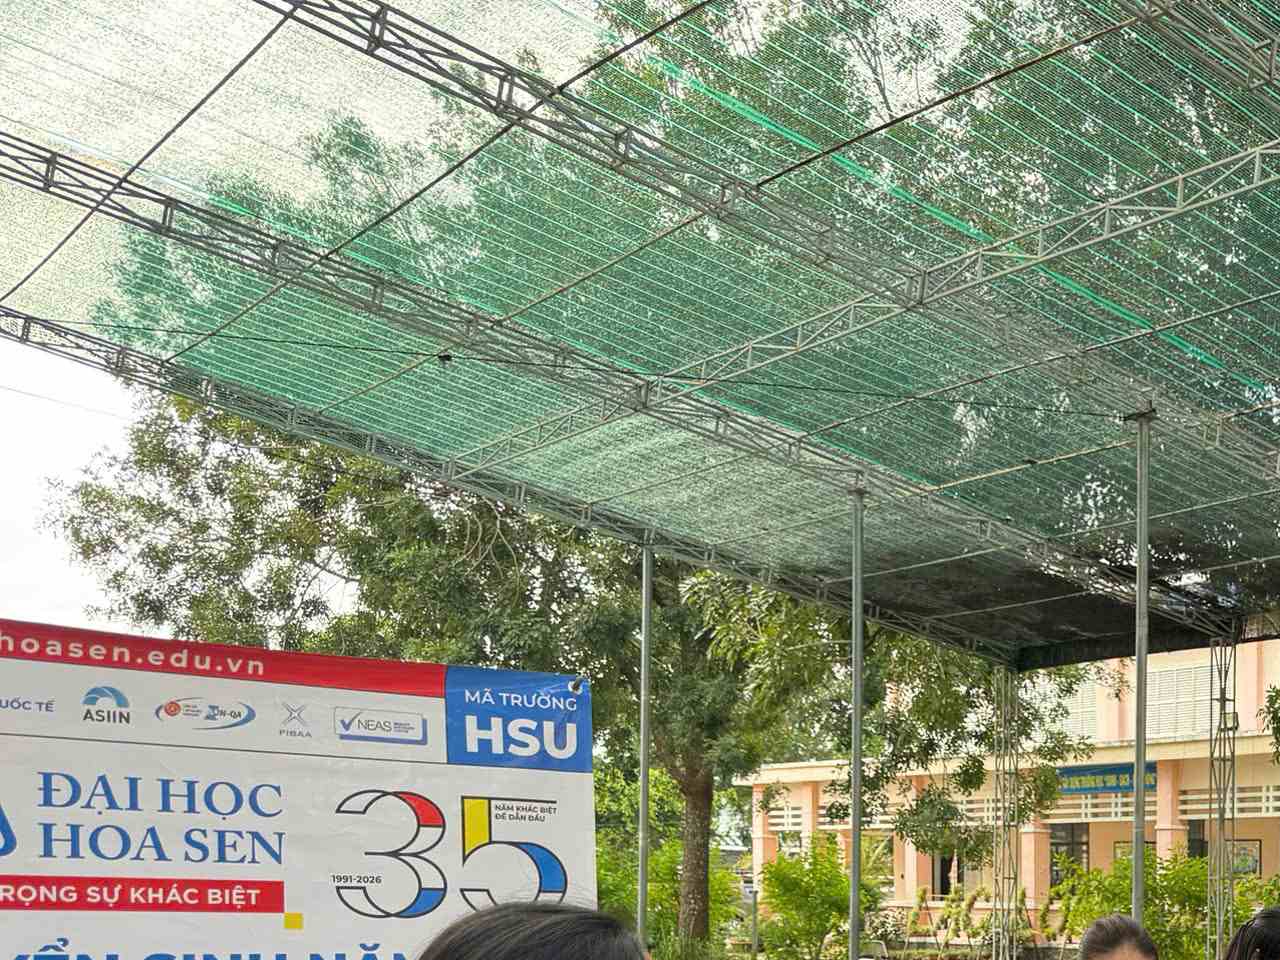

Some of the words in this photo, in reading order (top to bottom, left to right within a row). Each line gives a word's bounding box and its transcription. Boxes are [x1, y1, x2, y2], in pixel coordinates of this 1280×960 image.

[0, 632, 264, 675] hoasen.edu.vn
[0, 697, 31, 711] UỐC
[36, 698, 55, 712] TẾ
[465, 688, 495, 705] MÃ
[499, 690, 577, 711] TRƯỜNG
[83, 709, 130, 724] ASIIN
[357, 719, 392, 733] NEAS
[465, 715, 577, 760] HSU
[37, 771, 142, 815] ĐẠI
[156, 778, 283, 820] HỌC
[38, 823, 172, 861] HOA
[184, 828, 286, 864] SEN
[336, 789, 568, 918] 35
[331, 874, 382, 884] 1991-2026
[0, 885, 77, 906] RỌNG
[87, 884, 122, 907] SỰ
[131, 883, 199, 904] KHÁC
[208, 886, 260, 908] BIỆT
